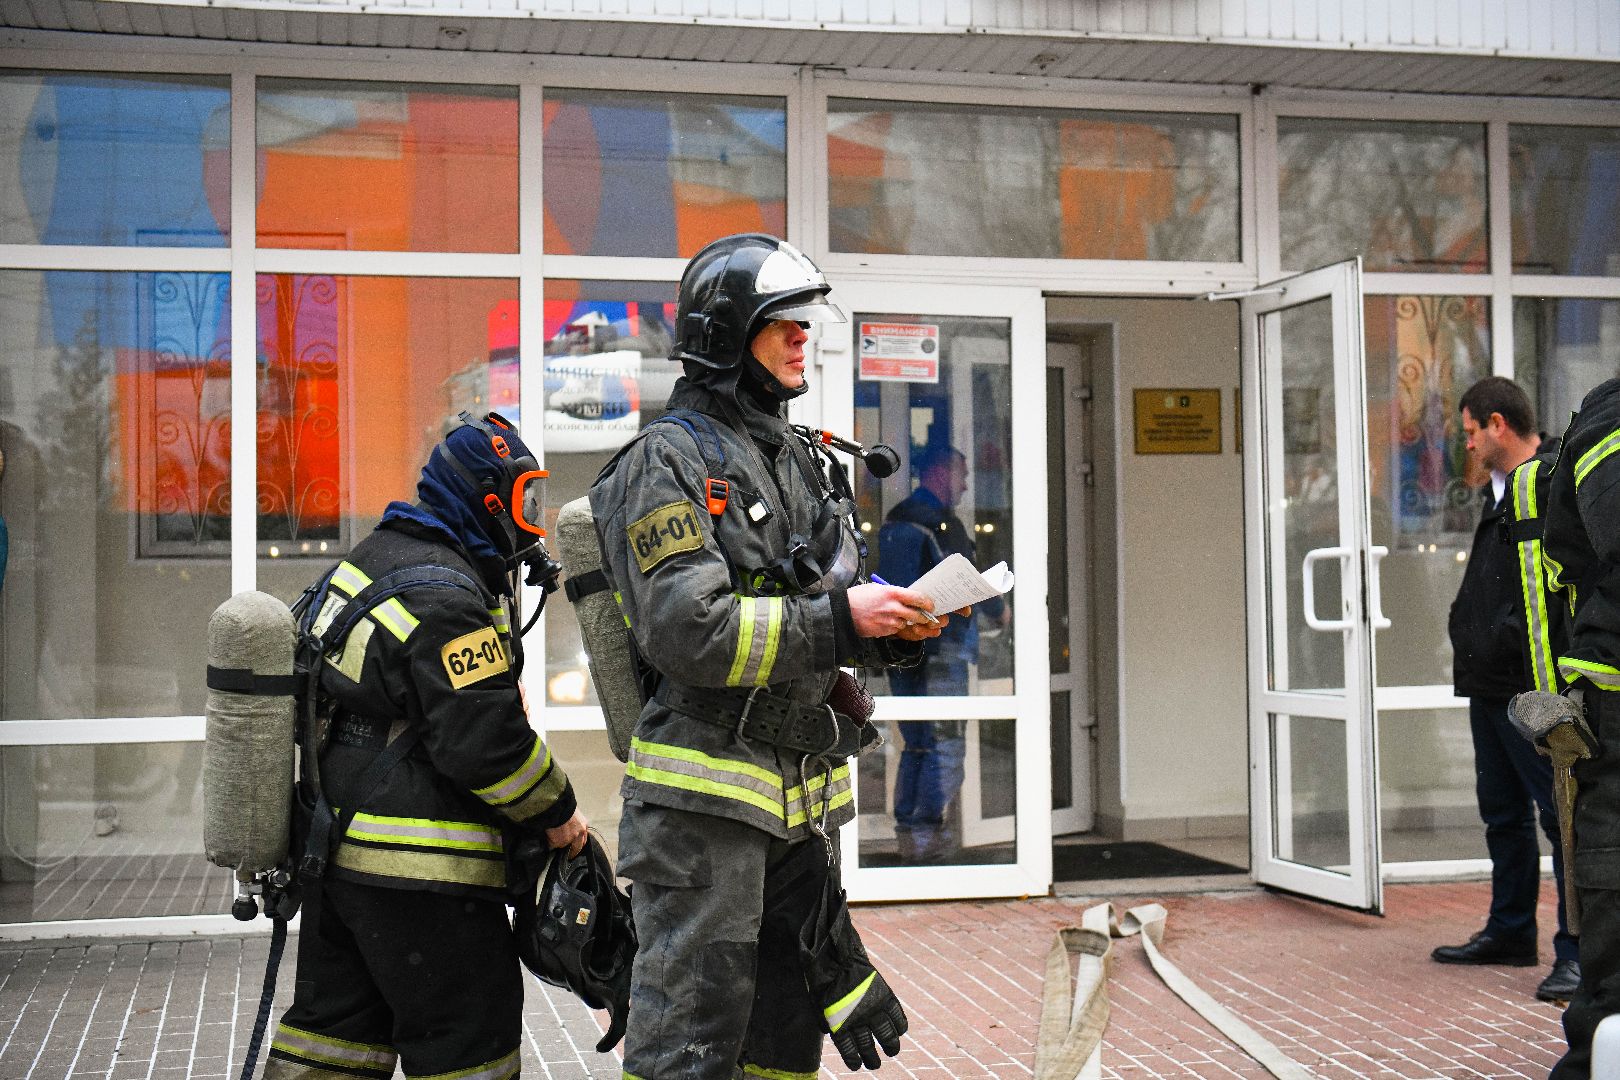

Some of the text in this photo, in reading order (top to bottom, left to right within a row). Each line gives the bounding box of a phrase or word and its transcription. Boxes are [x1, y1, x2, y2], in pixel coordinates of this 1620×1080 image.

[560, 401, 625, 415] ХИМКИ
[636, 512, 697, 558] 64-01
[448, 637, 503, 676] 62-01
